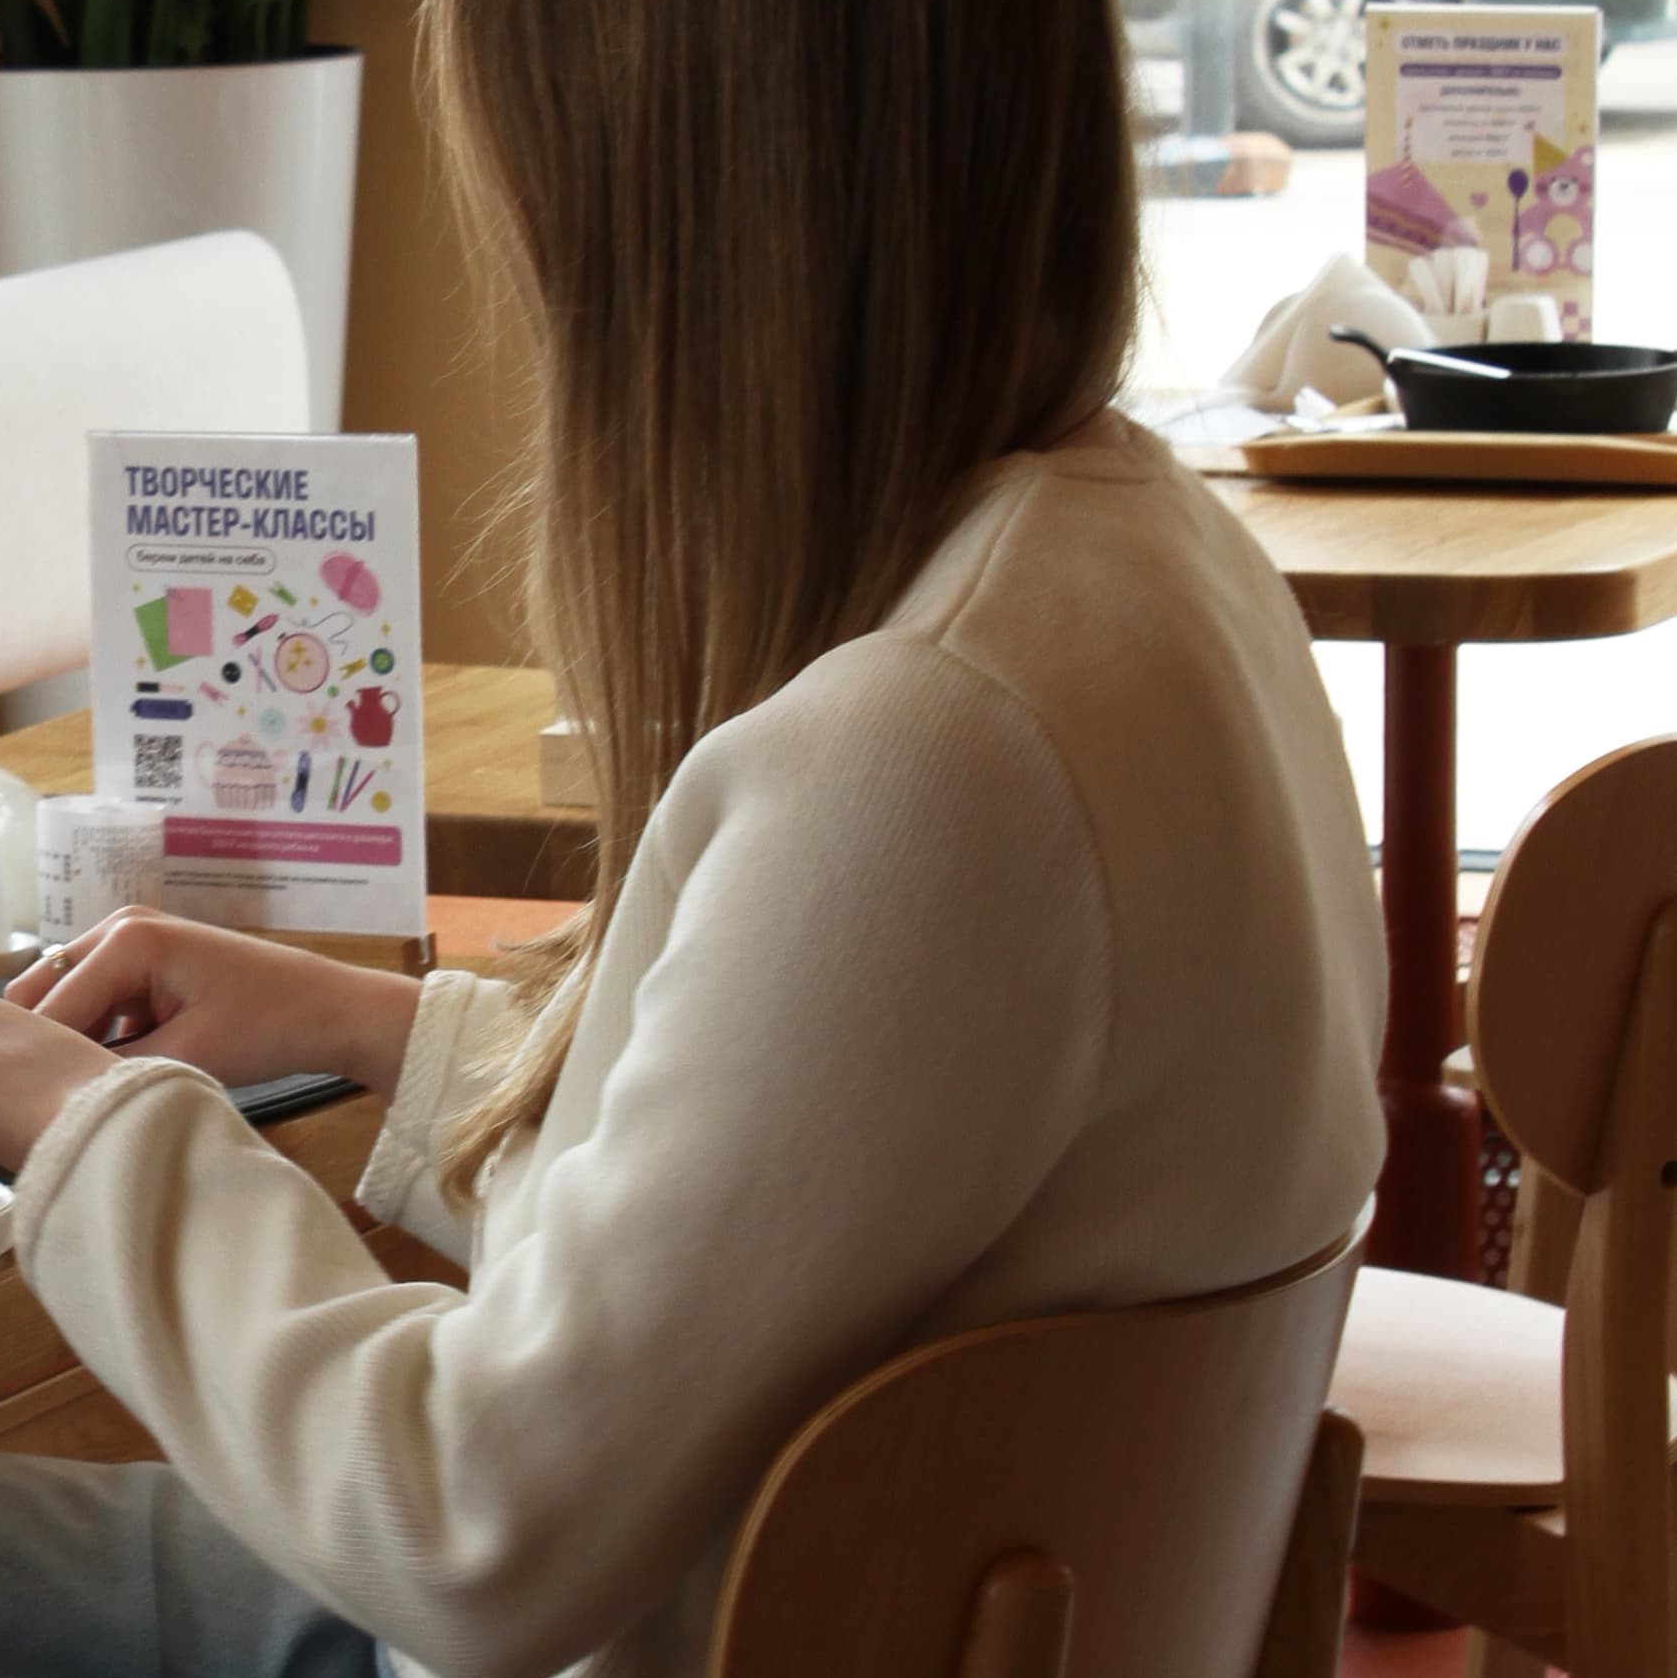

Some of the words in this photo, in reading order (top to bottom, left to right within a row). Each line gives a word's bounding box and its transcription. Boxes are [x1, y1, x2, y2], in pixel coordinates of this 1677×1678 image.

[1401, 35, 1450, 50] ОТМЕТЬ
[1453, 36, 1521, 52] ПРАЗДНИК
[1535, 37, 1561, 52] НАС
[125, 465, 309, 501] ТВОРЧЕСКИЕ
[126, 504, 375, 542] МАСТЕР-КЛАССЫ
